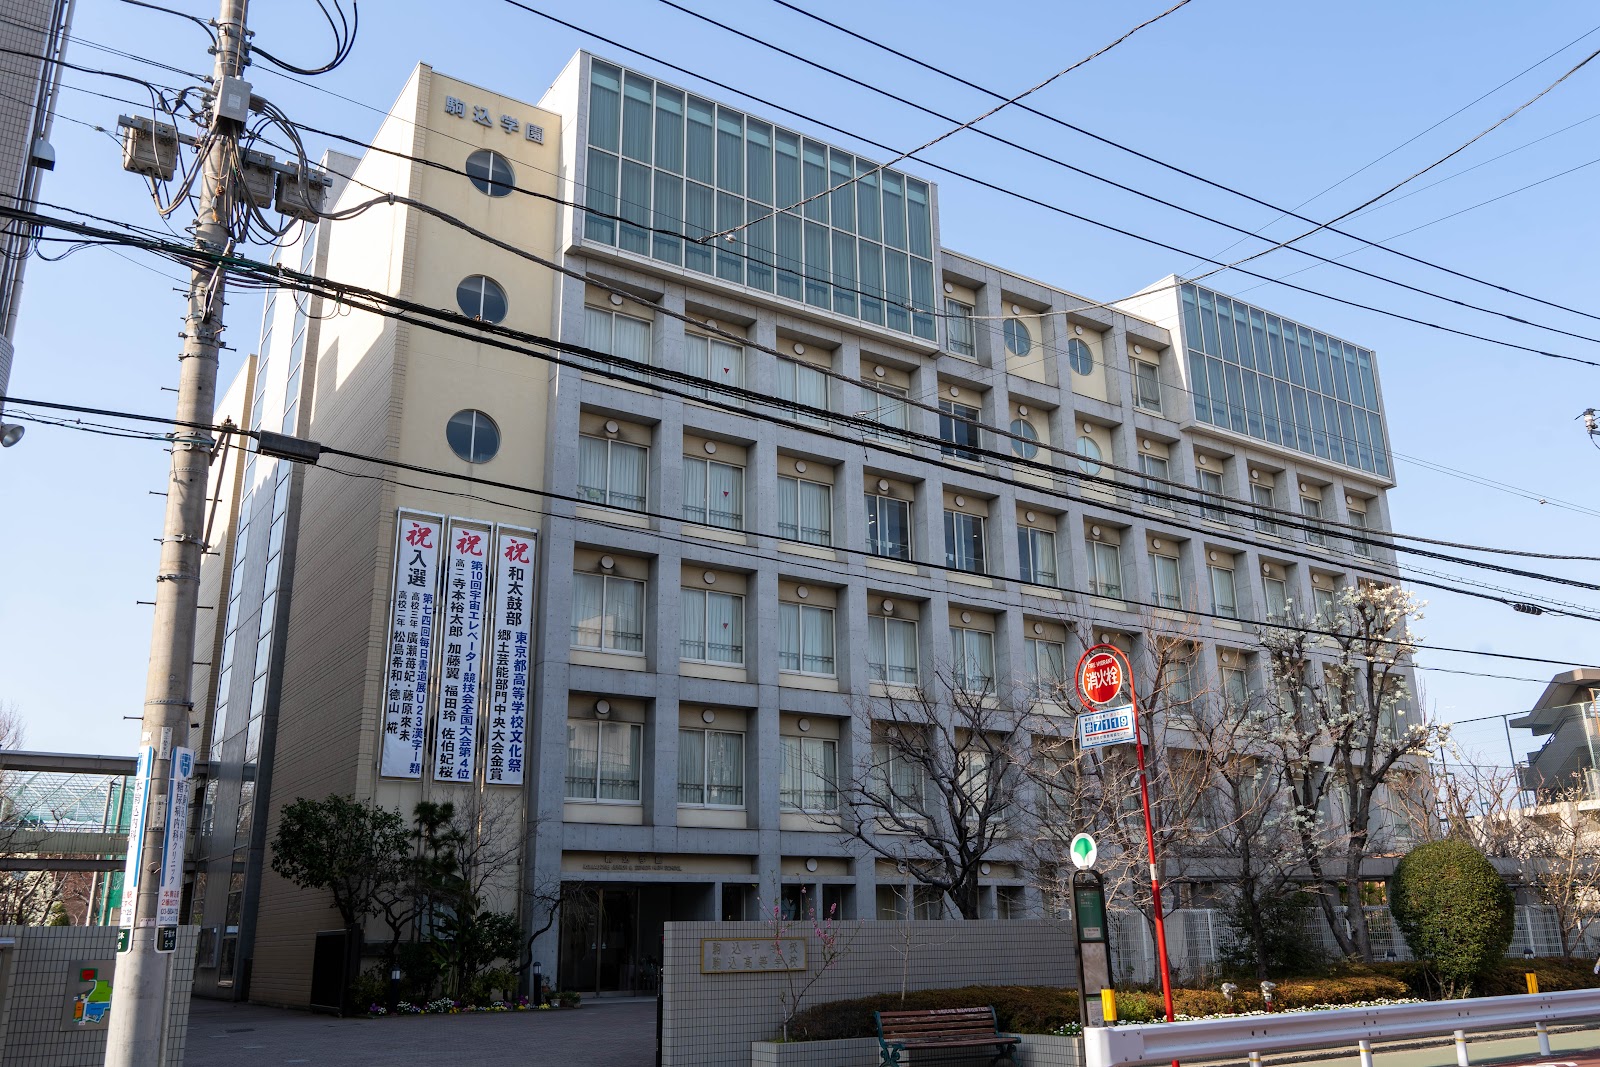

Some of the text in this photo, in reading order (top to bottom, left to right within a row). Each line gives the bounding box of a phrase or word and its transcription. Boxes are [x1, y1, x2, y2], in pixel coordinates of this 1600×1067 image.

[445, 95, 544, 145] 駒込学園
[405, 522, 433, 549] 祝
[455, 530, 483, 556] 祝
[504, 538, 530, 564] 祝
[407, 549, 427, 588] 入選
[505, 566, 524, 627] 和太鼓部
[1086, 665, 1119, 691] 消火栓
[489, 629, 511, 781] 郷土芸能部門中央大会金賞
[507, 631, 527, 773] 東京都高等学校文化祭
[1085, 715, 1129, 734] #7119
